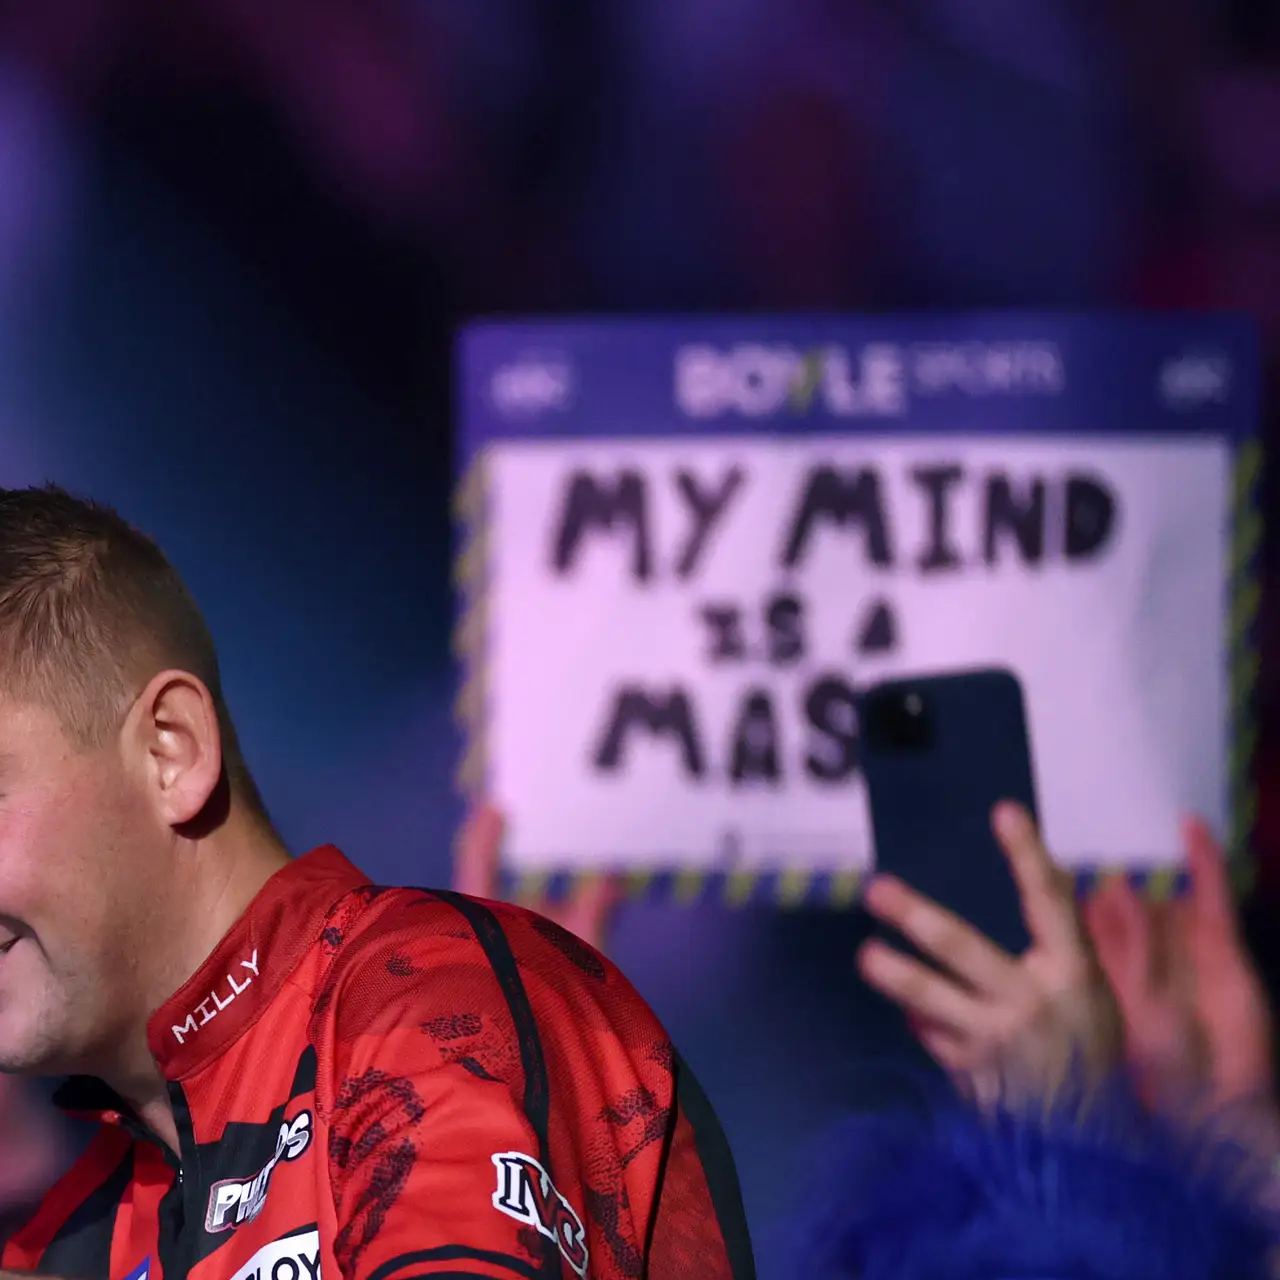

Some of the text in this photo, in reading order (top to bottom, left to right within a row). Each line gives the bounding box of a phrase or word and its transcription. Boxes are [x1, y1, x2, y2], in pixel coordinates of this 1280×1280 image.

[548, 458, 1123, 583] MY MIND
[171, 949, 262, 1044] MILLY
